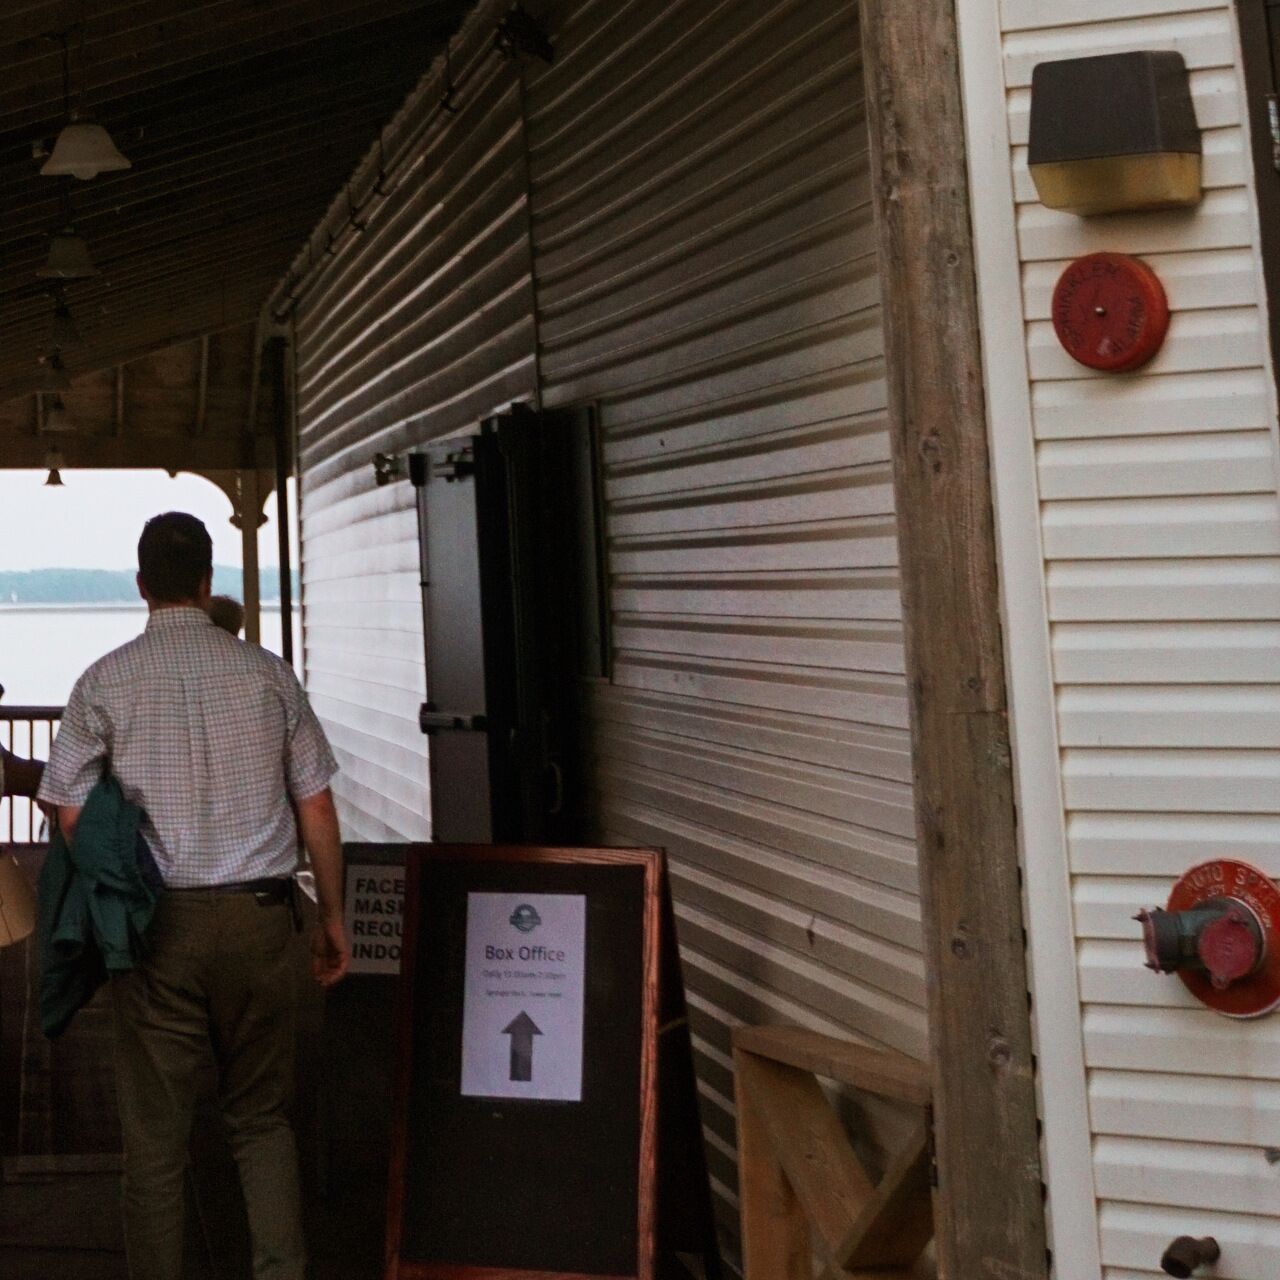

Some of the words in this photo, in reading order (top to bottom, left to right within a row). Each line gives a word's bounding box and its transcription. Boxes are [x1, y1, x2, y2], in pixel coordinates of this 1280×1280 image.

[356, 878, 405, 894] FACE
[485, 945, 514, 960] Box
[519, 946, 565, 961] Office
